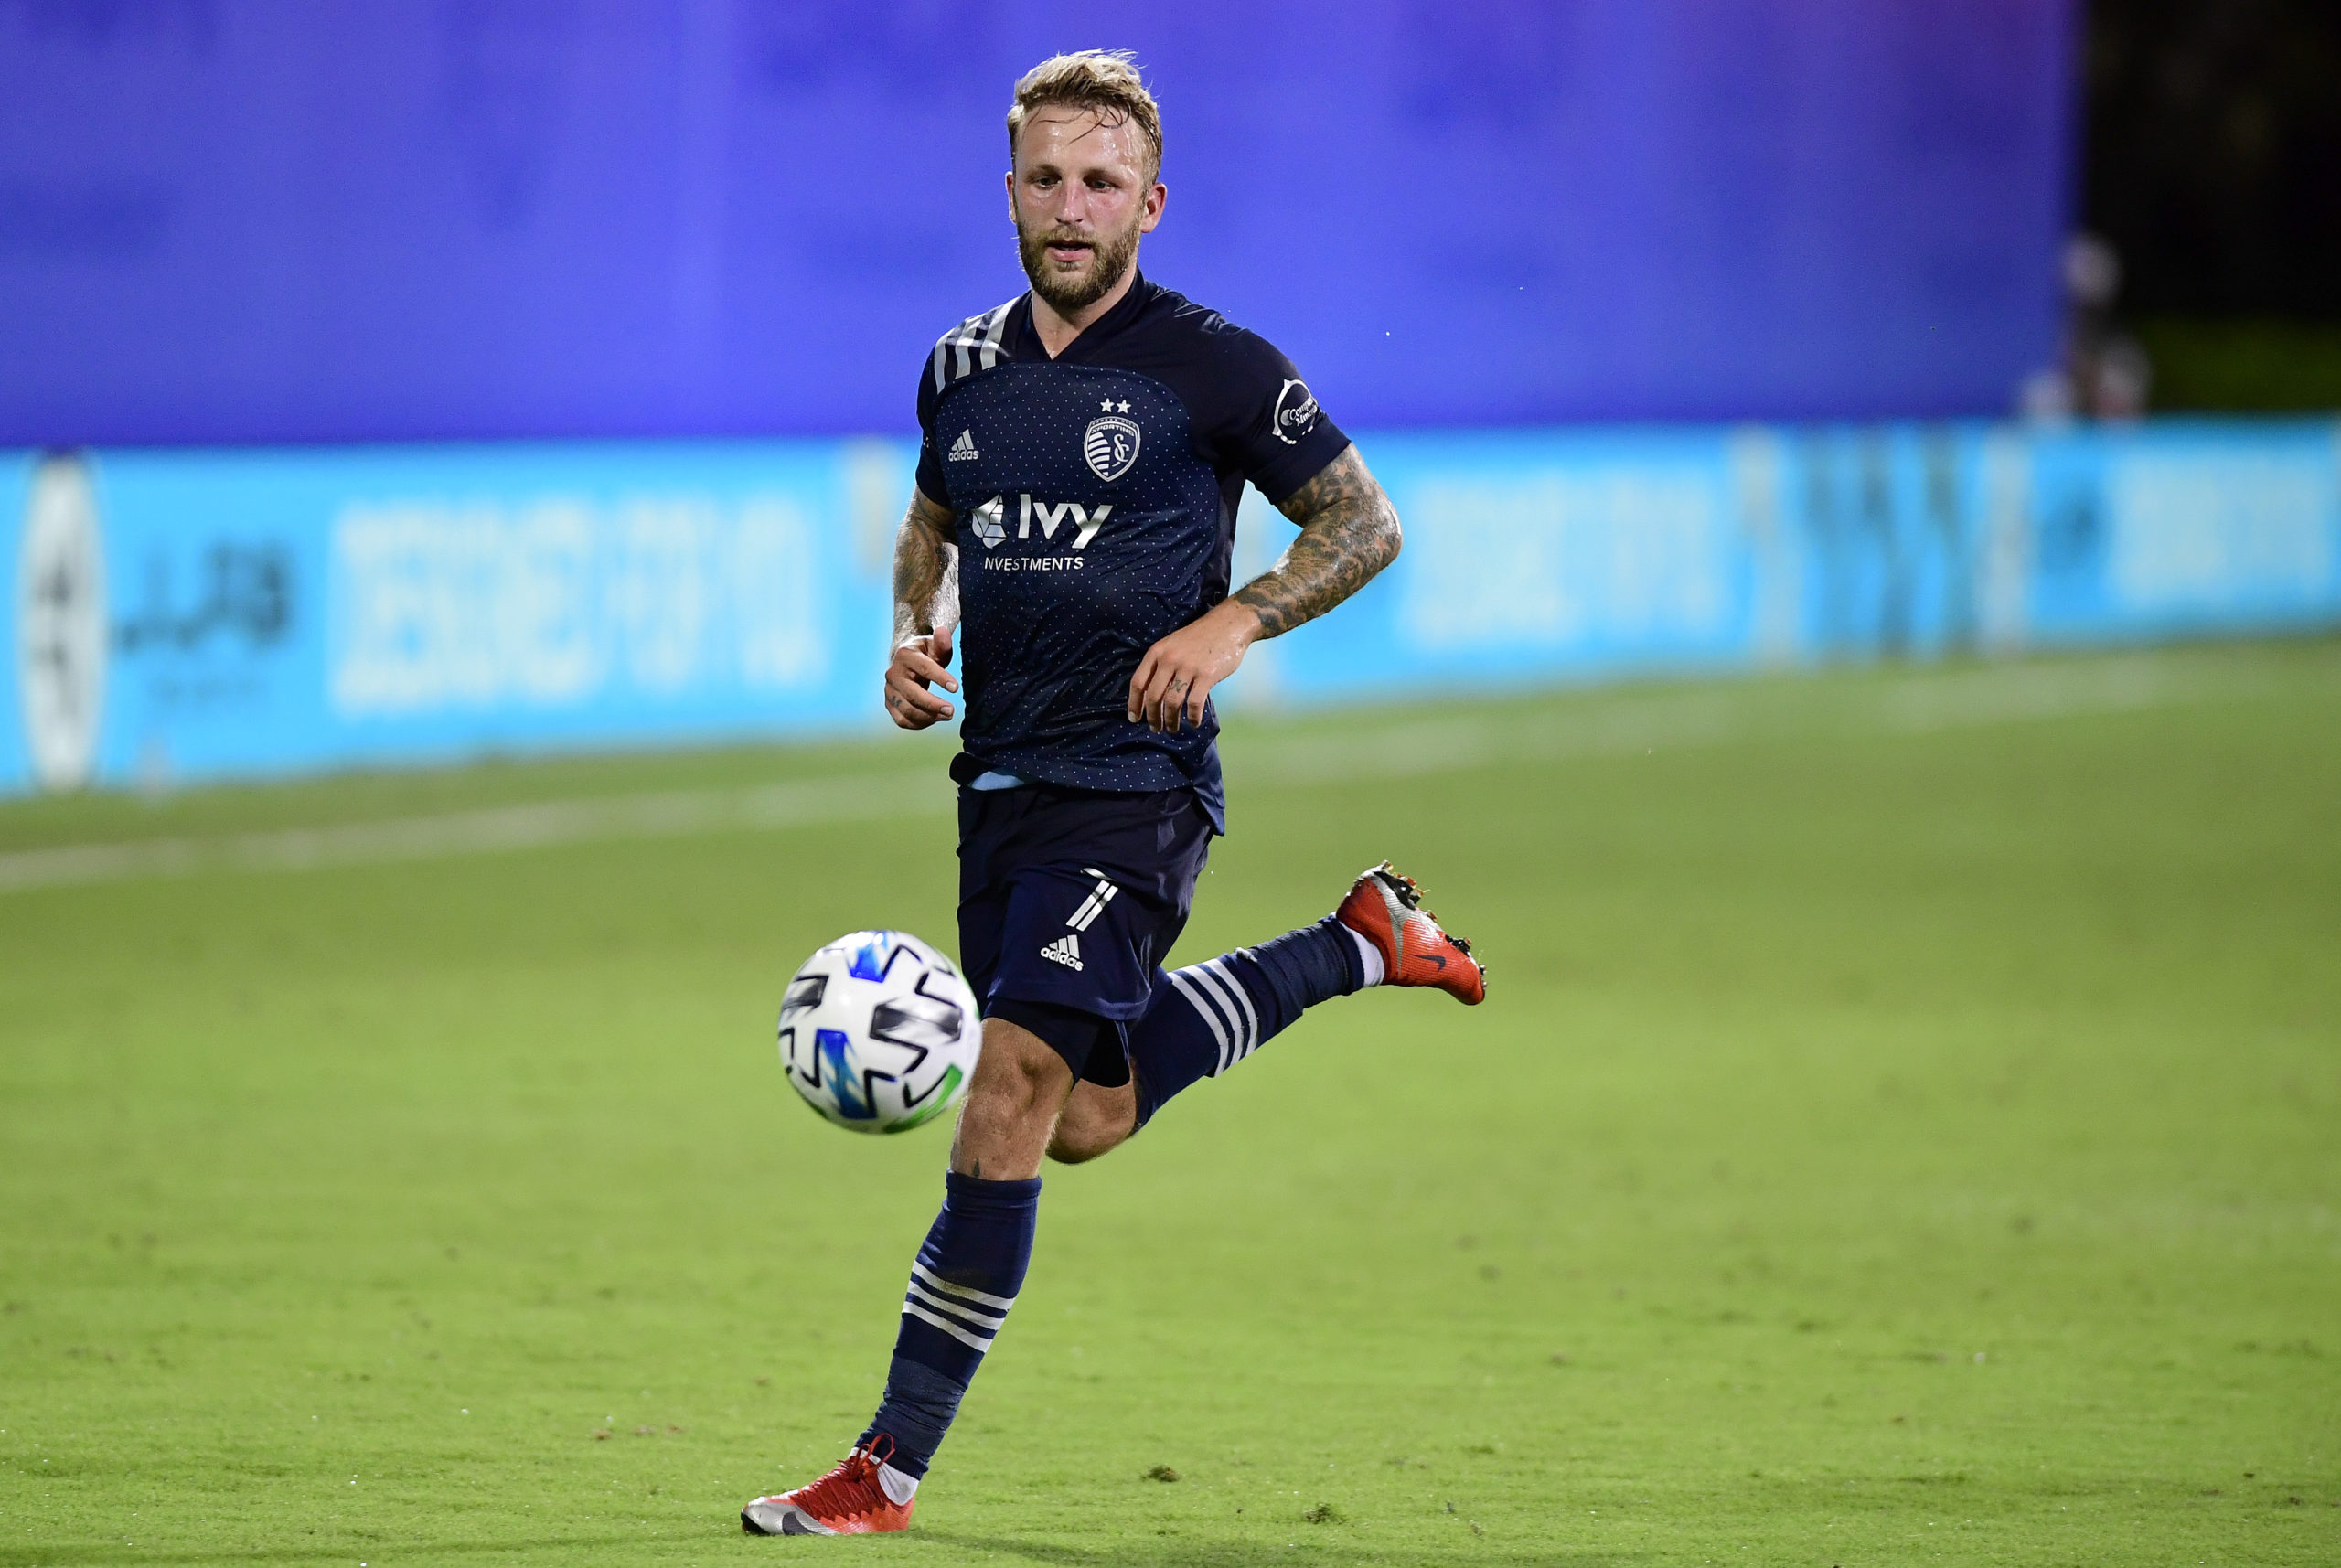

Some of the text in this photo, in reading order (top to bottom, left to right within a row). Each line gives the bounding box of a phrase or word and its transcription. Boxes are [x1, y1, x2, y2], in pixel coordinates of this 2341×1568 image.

[948, 449, 978, 462] adidas
[1017, 494, 1113, 549] Ivy
[1041, 947, 1084, 971] adidas
